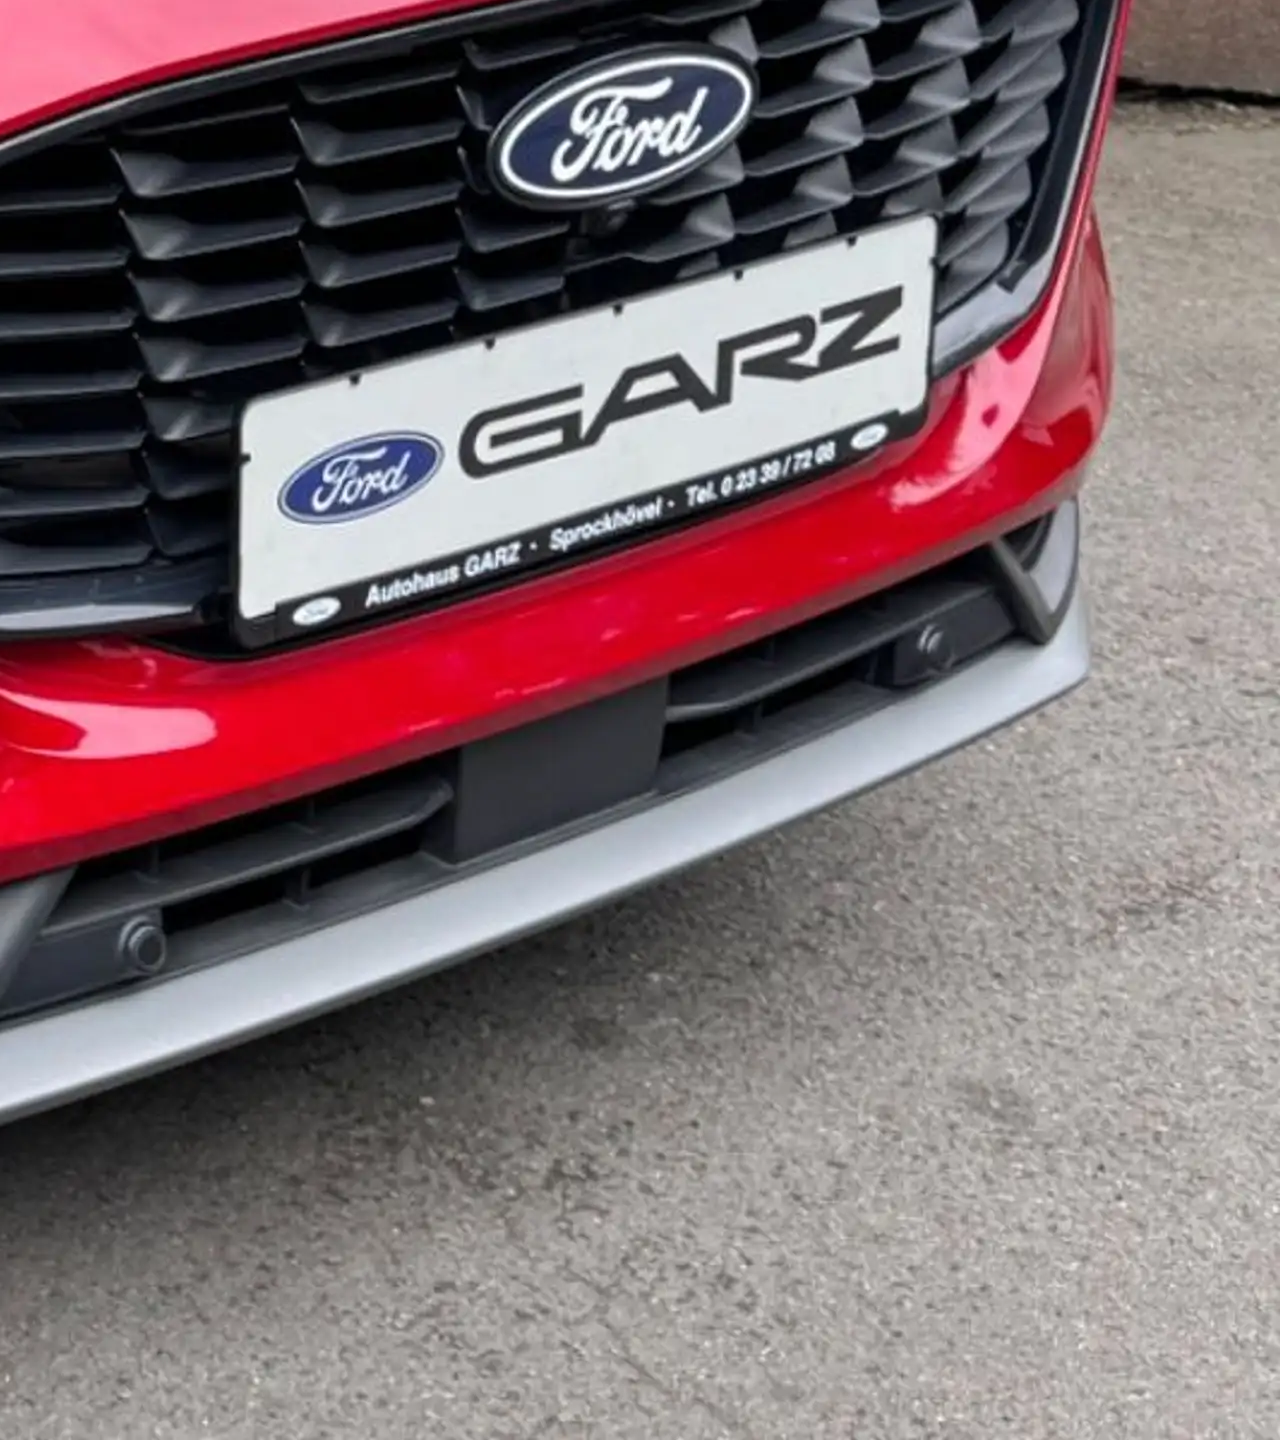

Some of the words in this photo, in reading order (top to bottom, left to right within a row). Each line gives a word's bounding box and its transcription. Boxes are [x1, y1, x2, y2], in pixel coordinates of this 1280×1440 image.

[551, 76, 709, 182] Ford
[458, 284, 904, 479] GARZ
[312, 446, 411, 512] Ford
[365, 564, 460, 608] Autohaus
[463, 540, 523, 578] GARZ
[549, 495, 663, 553] Sprockhövel
